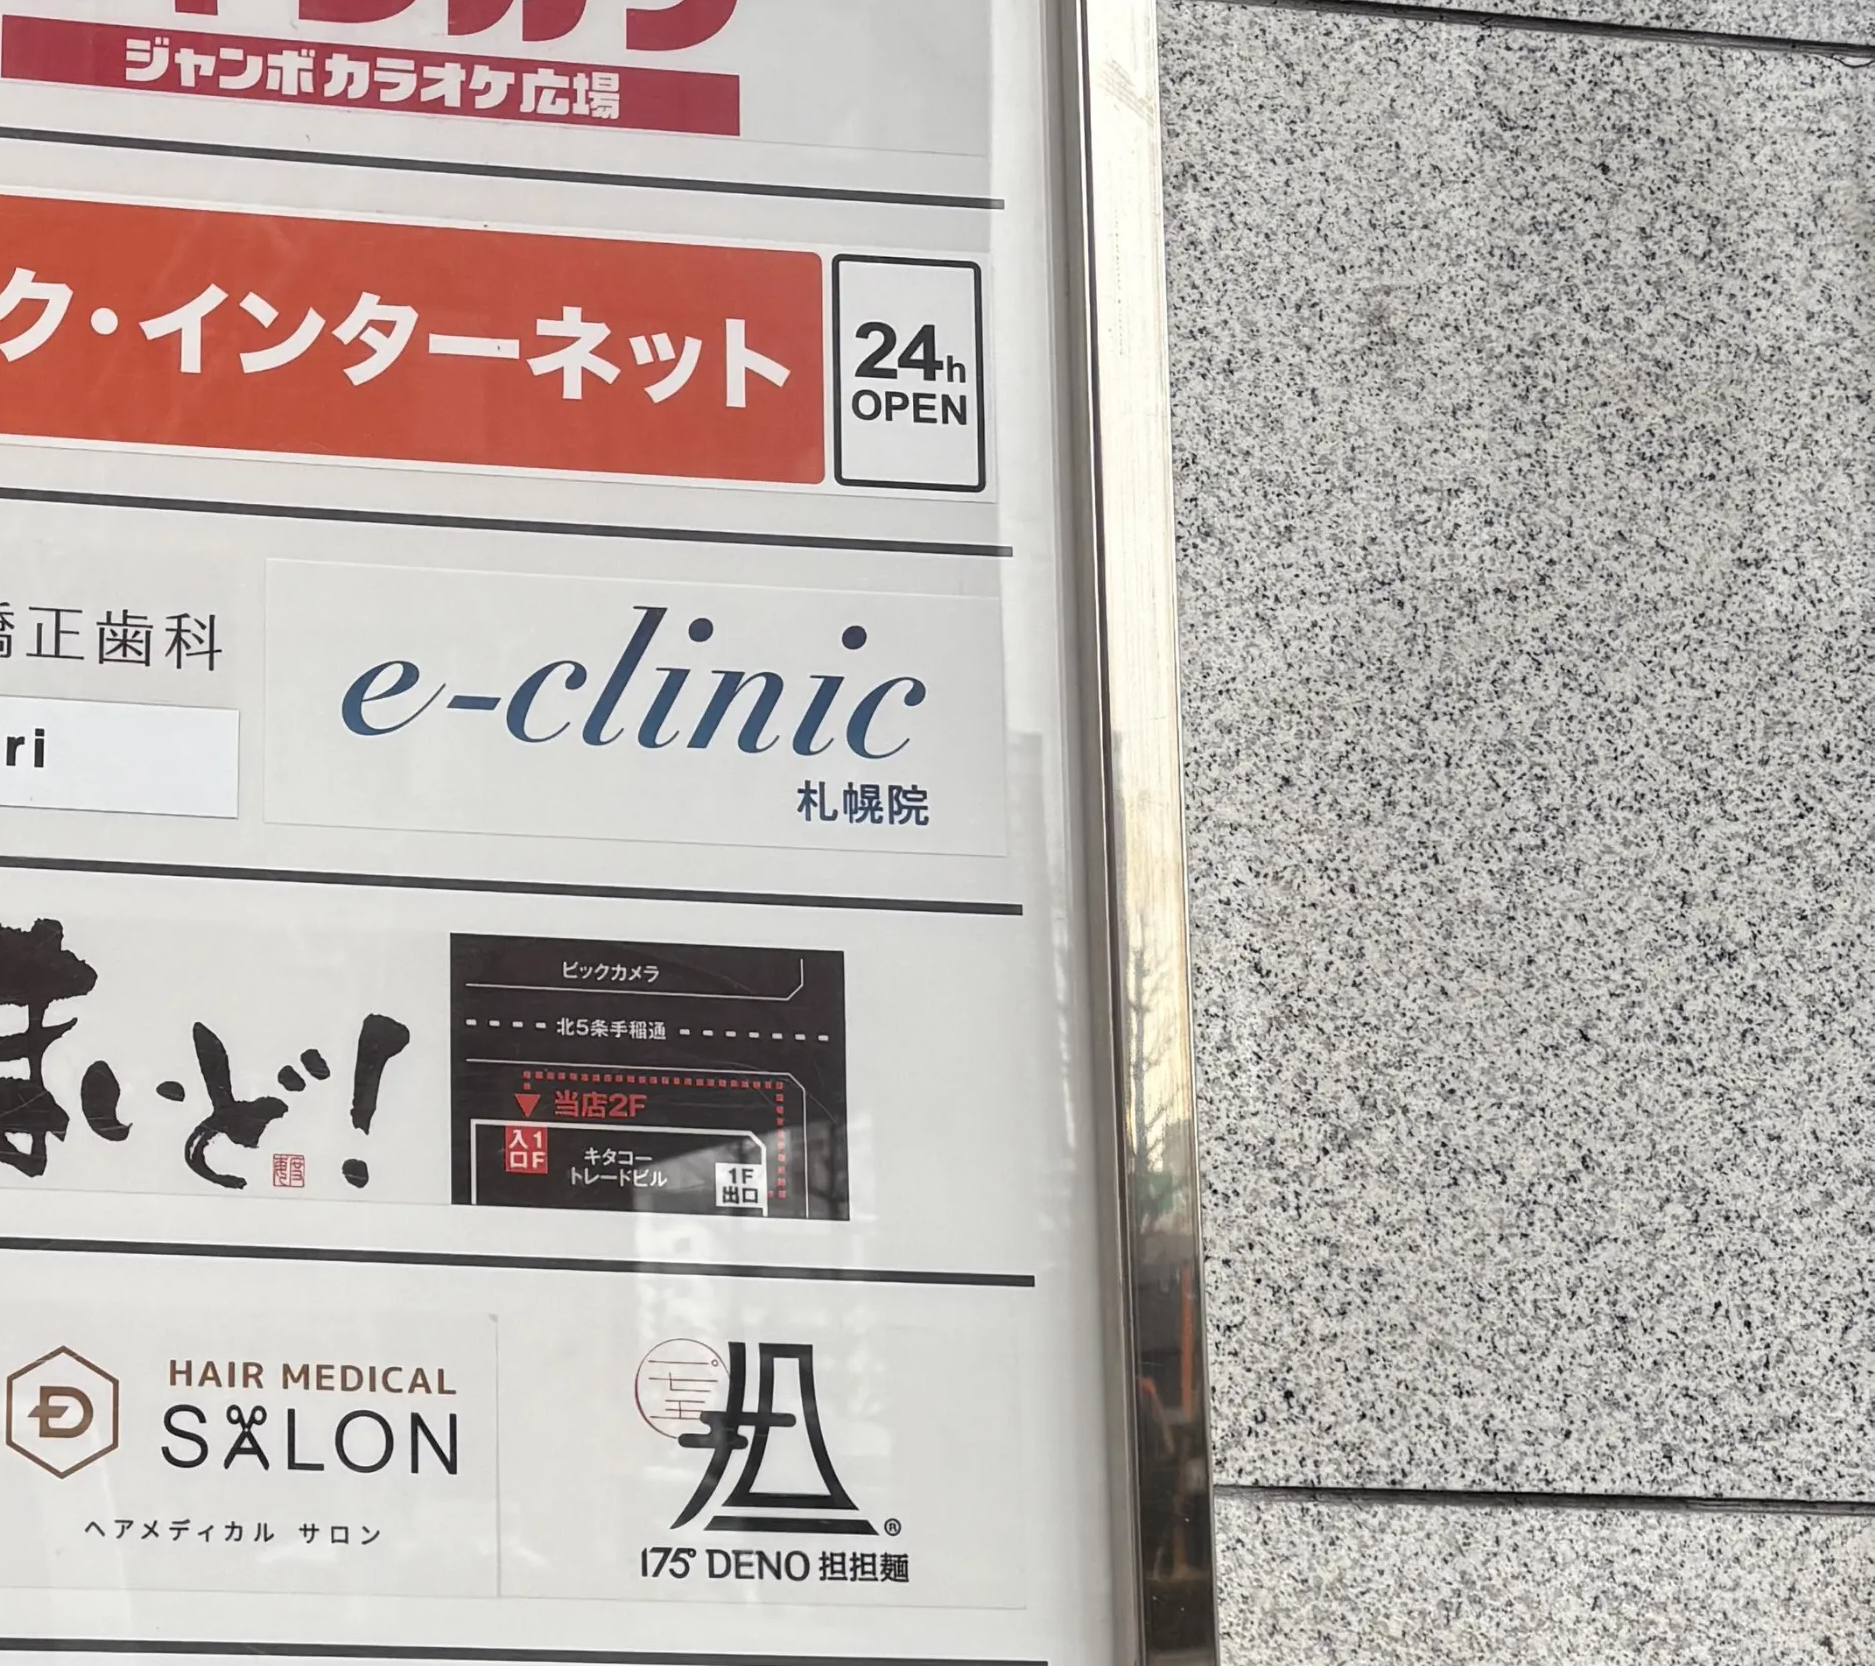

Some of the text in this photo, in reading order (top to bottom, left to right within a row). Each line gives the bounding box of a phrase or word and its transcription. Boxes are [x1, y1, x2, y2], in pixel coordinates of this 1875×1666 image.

[125, 37, 621, 121] ジャンボカラオケ広場
[853, 320, 967, 384] 24h
[851, 388, 968, 427] OPEN
[340, 604, 928, 761] e-clinic
[796, 779, 931, 827] 札幌院
[556, 1017, 667, 1040] 北5条手稲通
[554, 1089, 648, 1119] 当店2F
[583, 1146, 654, 1167] キタコー
[728, 1167, 755, 1185] 1F
[721, 1185, 759, 1206] 出口
[169, 1359, 458, 1396] HAIR MEDICAL
[160, 1403, 458, 1475] SALON
[84, 1518, 381, 1546] ヘアメディカル サロン
[705, 1548, 811, 1582] DENO
[818, 1550, 910, 1583] 担担麺
